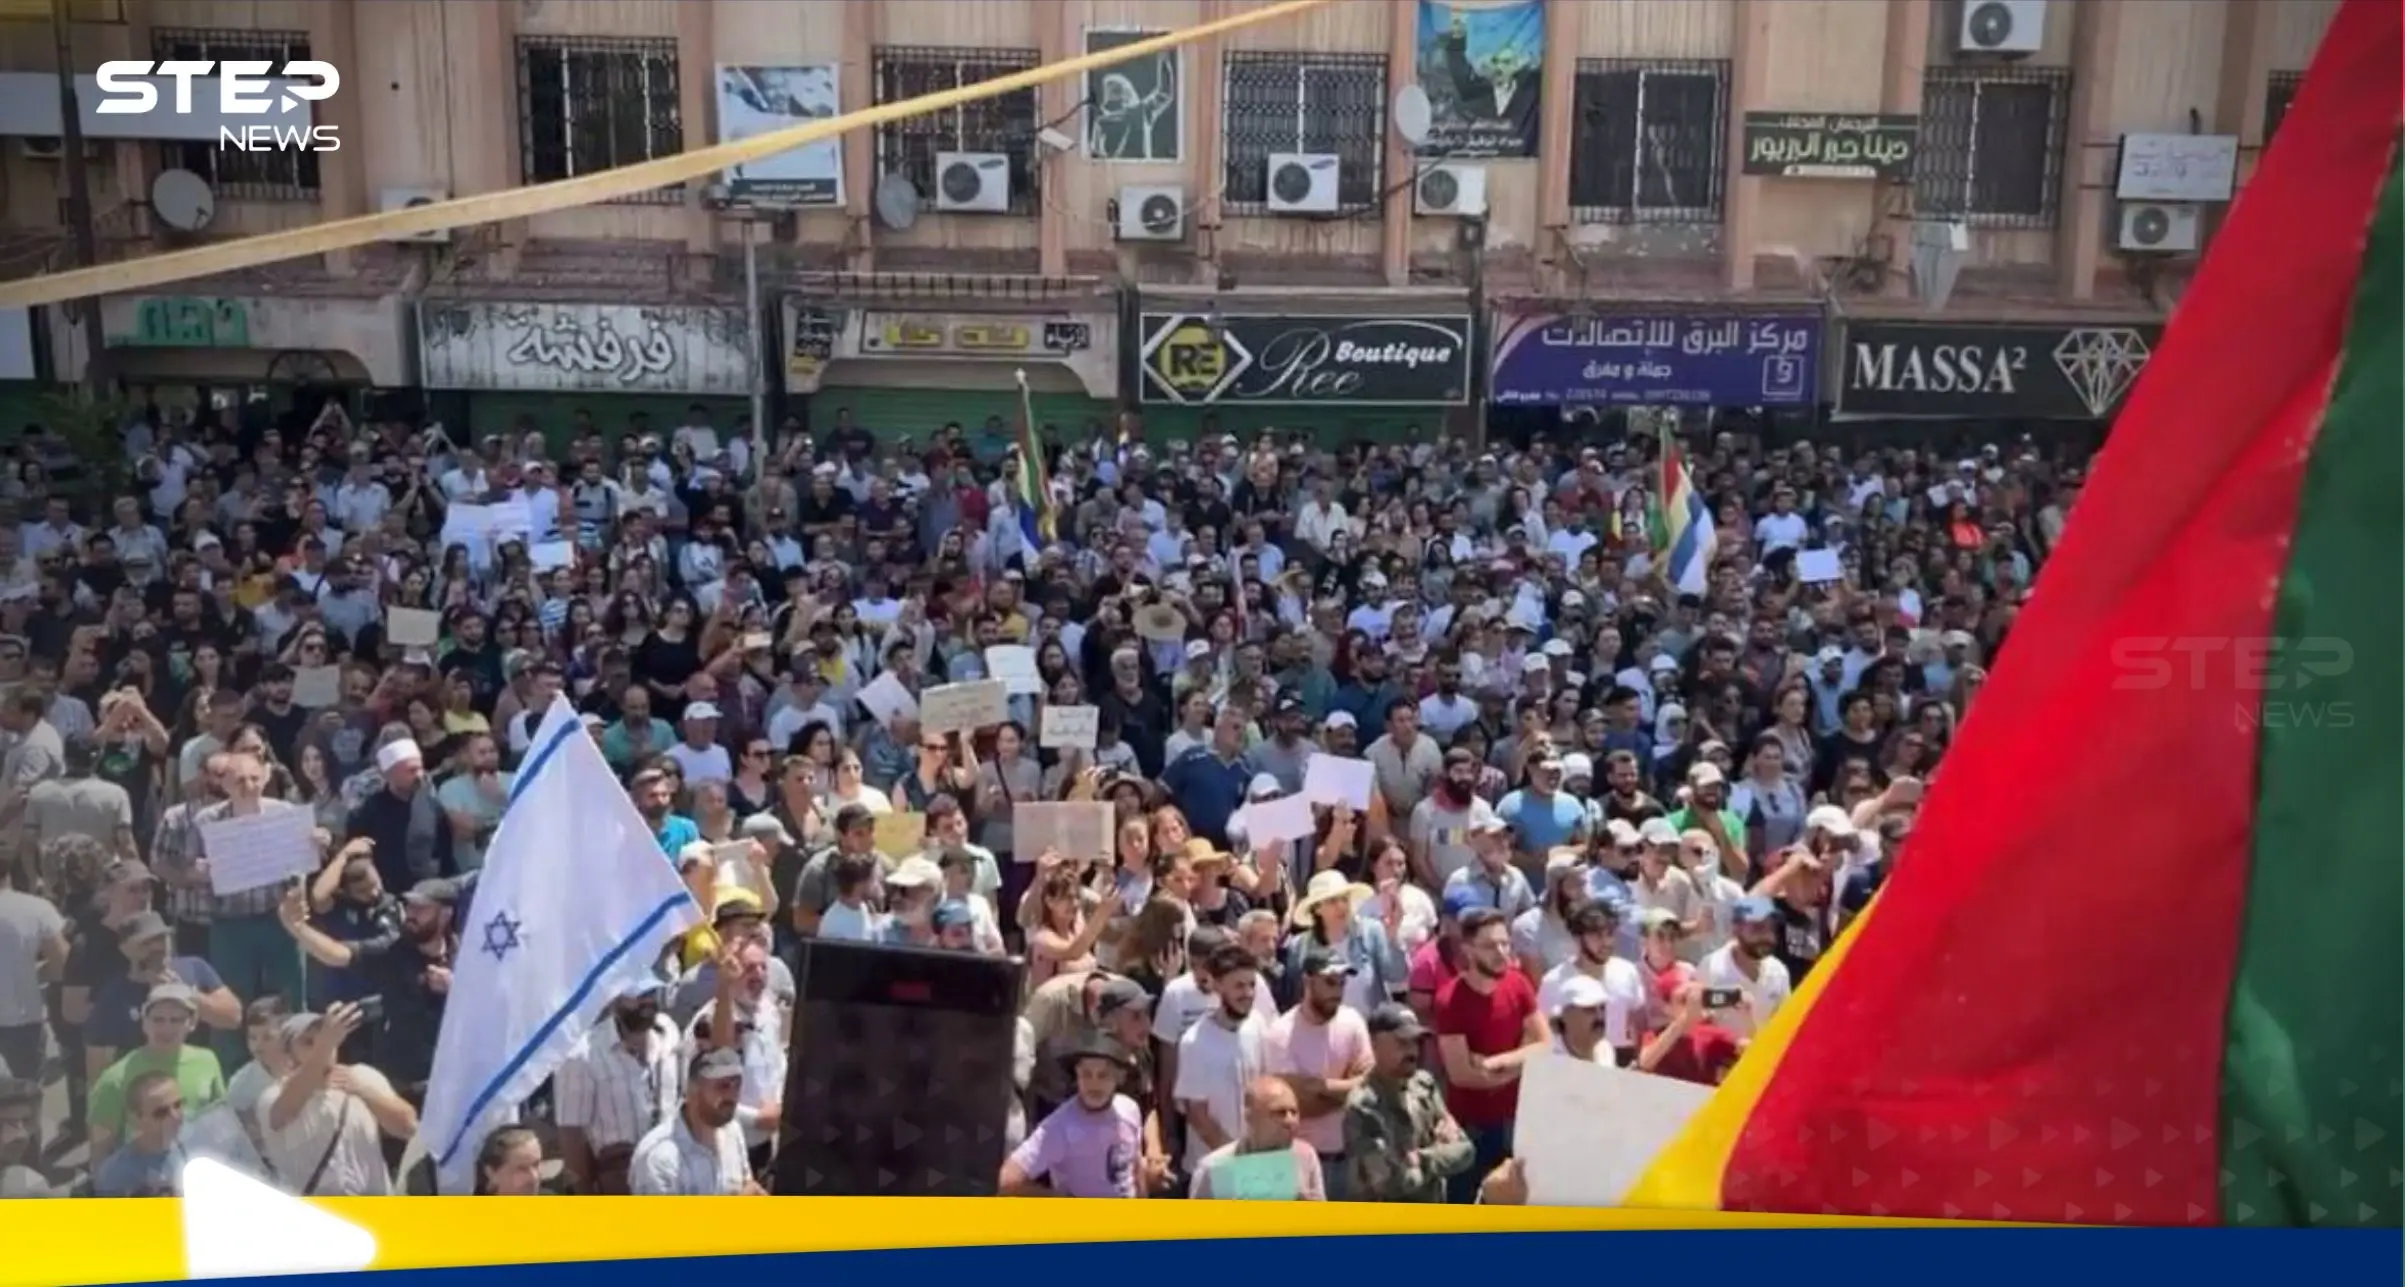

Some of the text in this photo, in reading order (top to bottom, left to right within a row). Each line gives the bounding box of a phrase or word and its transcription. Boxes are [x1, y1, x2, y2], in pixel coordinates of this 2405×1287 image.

[506, 313, 675, 384] فرفشة
[1682, 319, 1740, 355] البرق
[1746, 321, 1809, 355] مركز
[1170, 343, 1219, 377] RE
[1235, 328, 1366, 398] Ree
[1335, 341, 1451, 368] Boutique
[1581, 360, 1674, 382] جملة و مفرق
